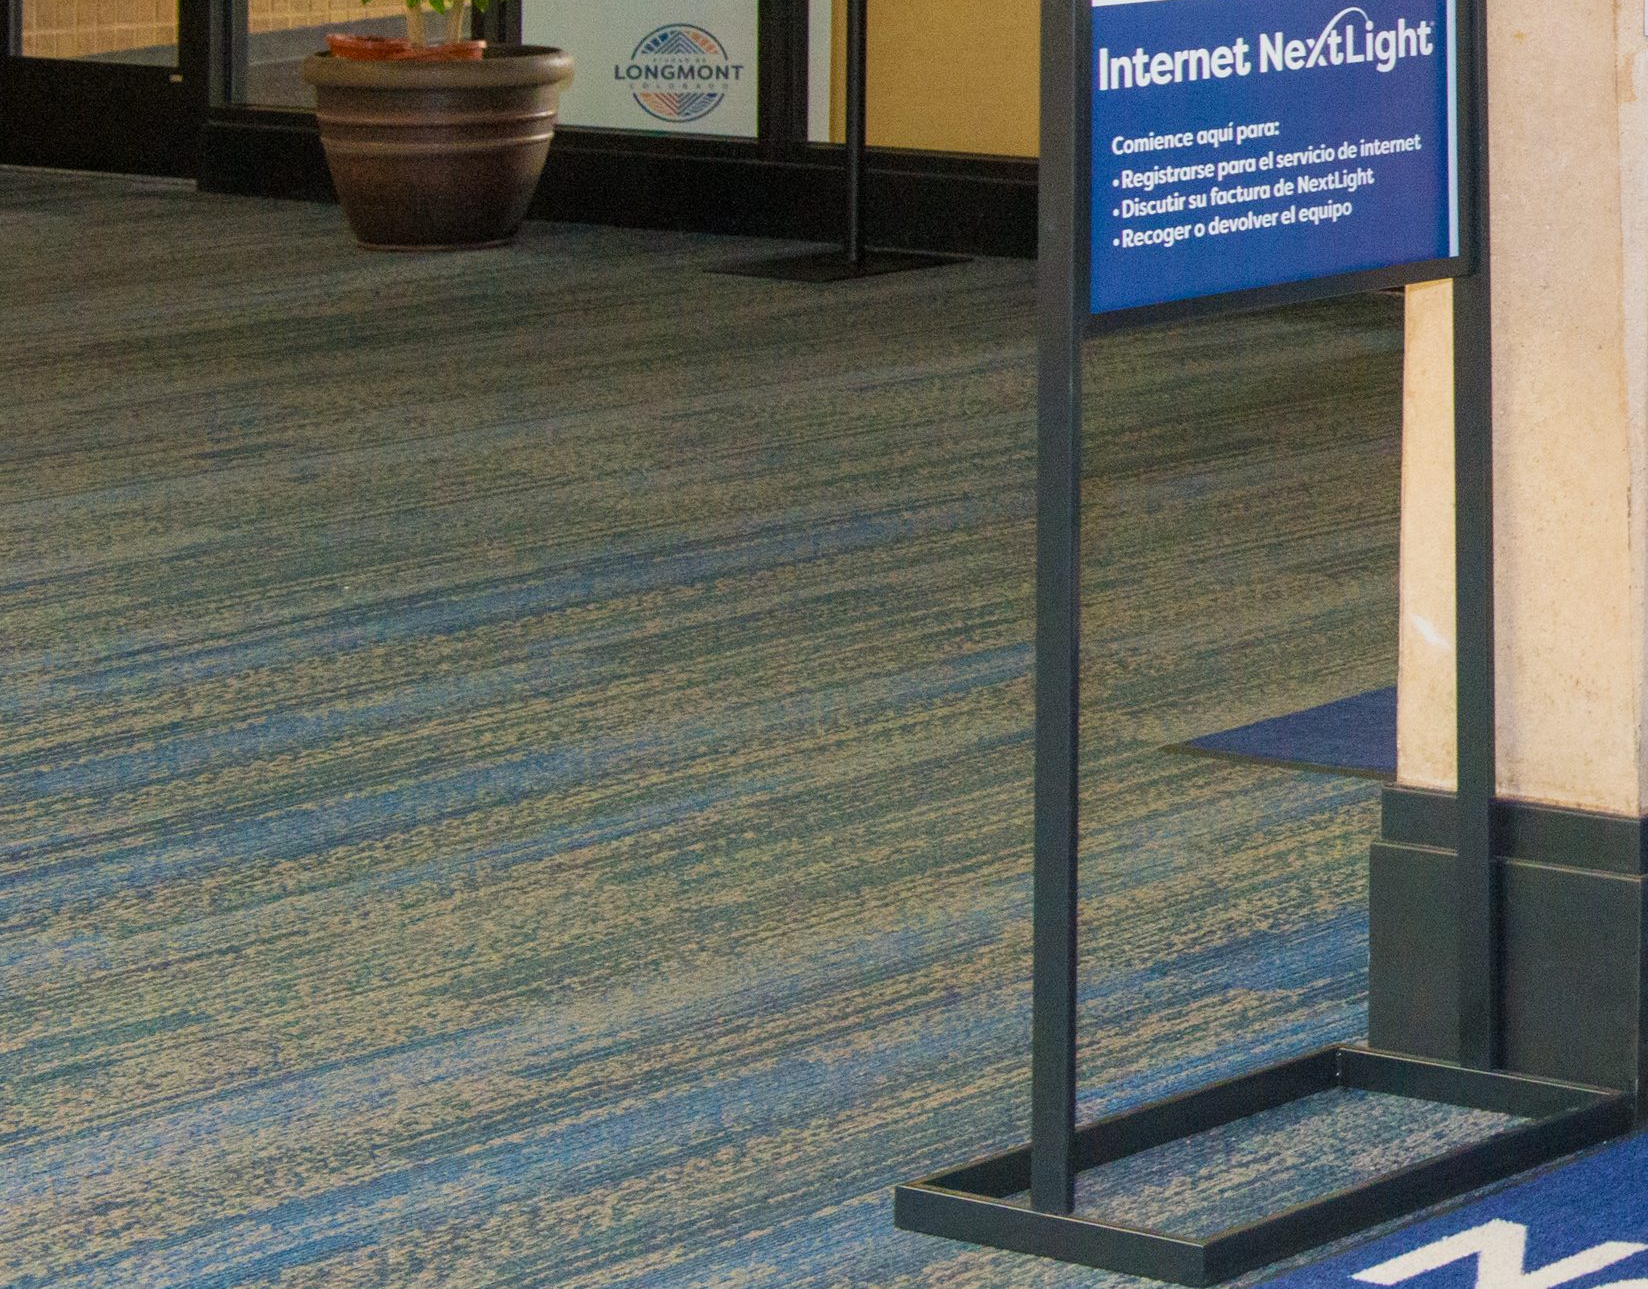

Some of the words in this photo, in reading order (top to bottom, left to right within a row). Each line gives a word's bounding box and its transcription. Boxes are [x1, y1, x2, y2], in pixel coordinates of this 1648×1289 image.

[614, 64, 744, 81] LONGMONT
[1099, 37, 1252, 91] Internet
[1112, 131, 1194, 156] Comience
[1197, 122, 1234, 153] aquí
[1236, 120, 1280, 145] para:
[1121, 163, 1215, 192] Registrarse
[1217, 159, 1256, 181] para
[1259, 152, 1274, 170] el
[1276, 144, 1334, 169] servicio
[1338, 142, 1357, 161] de
[1360, 134, 1422, 156] internet
[1121, 194, 1186, 219] Discutir
[1189, 194, 1207, 210] su
[1210, 185, 1271, 207] factura
[1273, 178, 1294, 197] de
[1297, 168, 1374, 194] NextLight
[1121, 223, 1191, 249] Recoger
[1194, 223, 1205, 238] o
[1208, 212, 1278, 236] devolver
[1280, 207, 1296, 225] el
[1298, 200, 1353, 227] equipo
